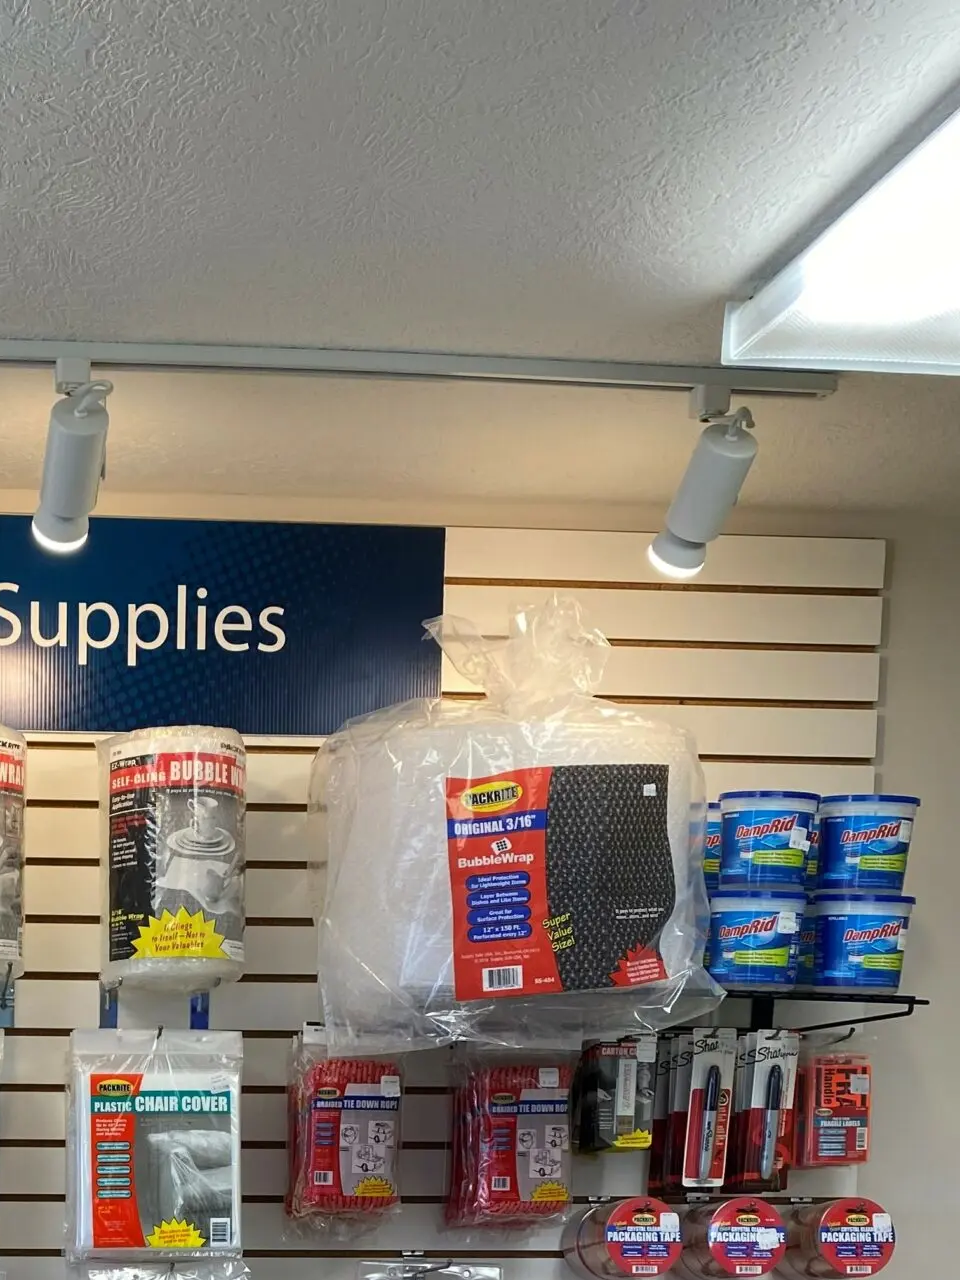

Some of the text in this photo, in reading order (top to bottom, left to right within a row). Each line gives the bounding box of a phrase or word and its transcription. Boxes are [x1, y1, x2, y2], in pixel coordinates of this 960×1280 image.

[170, 760, 228, 782] BUBBLE
[466, 785, 518, 806] ACKRITE
[454, 814, 537, 837] ORIGINAL 3/16"
[736, 814, 798, 839] DampRid
[841, 822, 901, 844] DampRid
[458, 852, 534, 869] BubbleWrap
[542, 912, 571, 929] Super
[720, 916, 778, 937] DampRid
[547, 925, 573, 941] Value
[843, 922, 901, 942] DampRid
[552, 937, 575, 952] Size!
[100, 1083, 131, 1092] PACKRITE
[823, 1068, 836, 1105] Handle
[94, 1095, 228, 1113] PLASTIC CHAIR COVER
[343, 1099, 355, 1109] TIE
[356, 1099, 379, 1109] DOWN
[519, 1103, 530, 1113] TIE
[531, 1103, 554, 1113] DOWN
[607, 1231, 681, 1242] PACKAGING TAPE
[821, 1231, 893, 1243] PACKAGING TAPE
